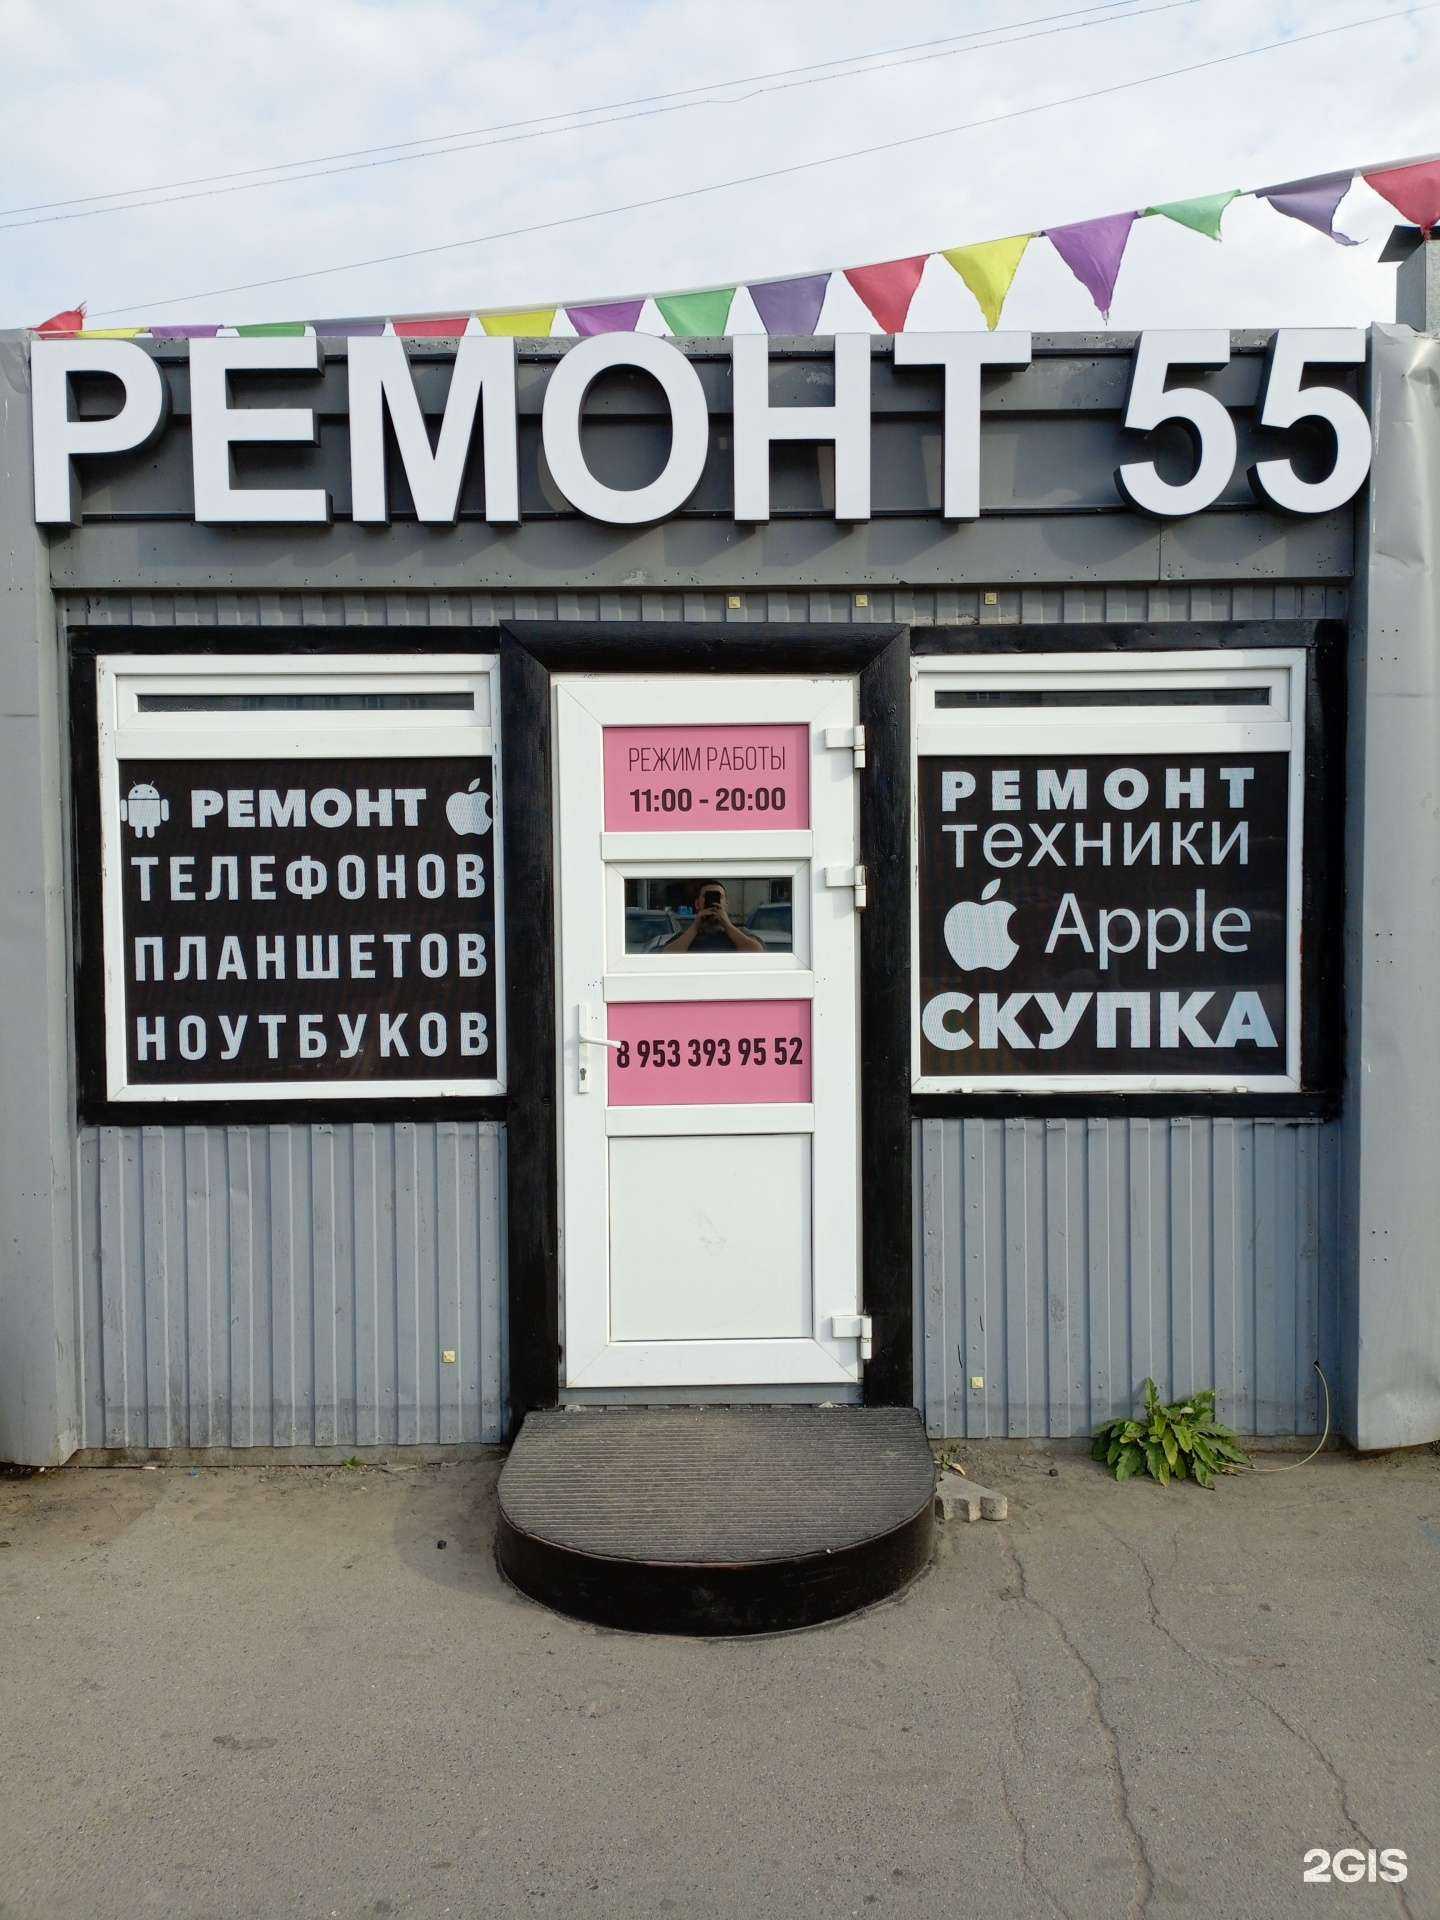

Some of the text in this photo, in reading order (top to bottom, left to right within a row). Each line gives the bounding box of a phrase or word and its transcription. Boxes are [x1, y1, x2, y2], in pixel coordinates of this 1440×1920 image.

[31, 328, 1373, 525] РЕМОНТ 55
[629, 746, 786, 772] РЕЖИМ РАБОТЫ
[191, 787, 427, 829] РЕМОНТ
[630, 788, 692, 812] 11:00
[716, 787, 786, 811] 20:00
[941, 767, 1255, 811] РЕМОНТ
[131, 854, 485, 902] ТЕЛЕФОНОВ
[1044, 888, 1251, 970] Apple
[135, 934, 487, 982] ПЛАНШЕТОВ
[136, 1012, 489, 1061] НОУТБУКОВ
[921, 991, 1278, 1051] СКУПКА
[616, 1037, 803, 1068] 8 953 393 95 52
